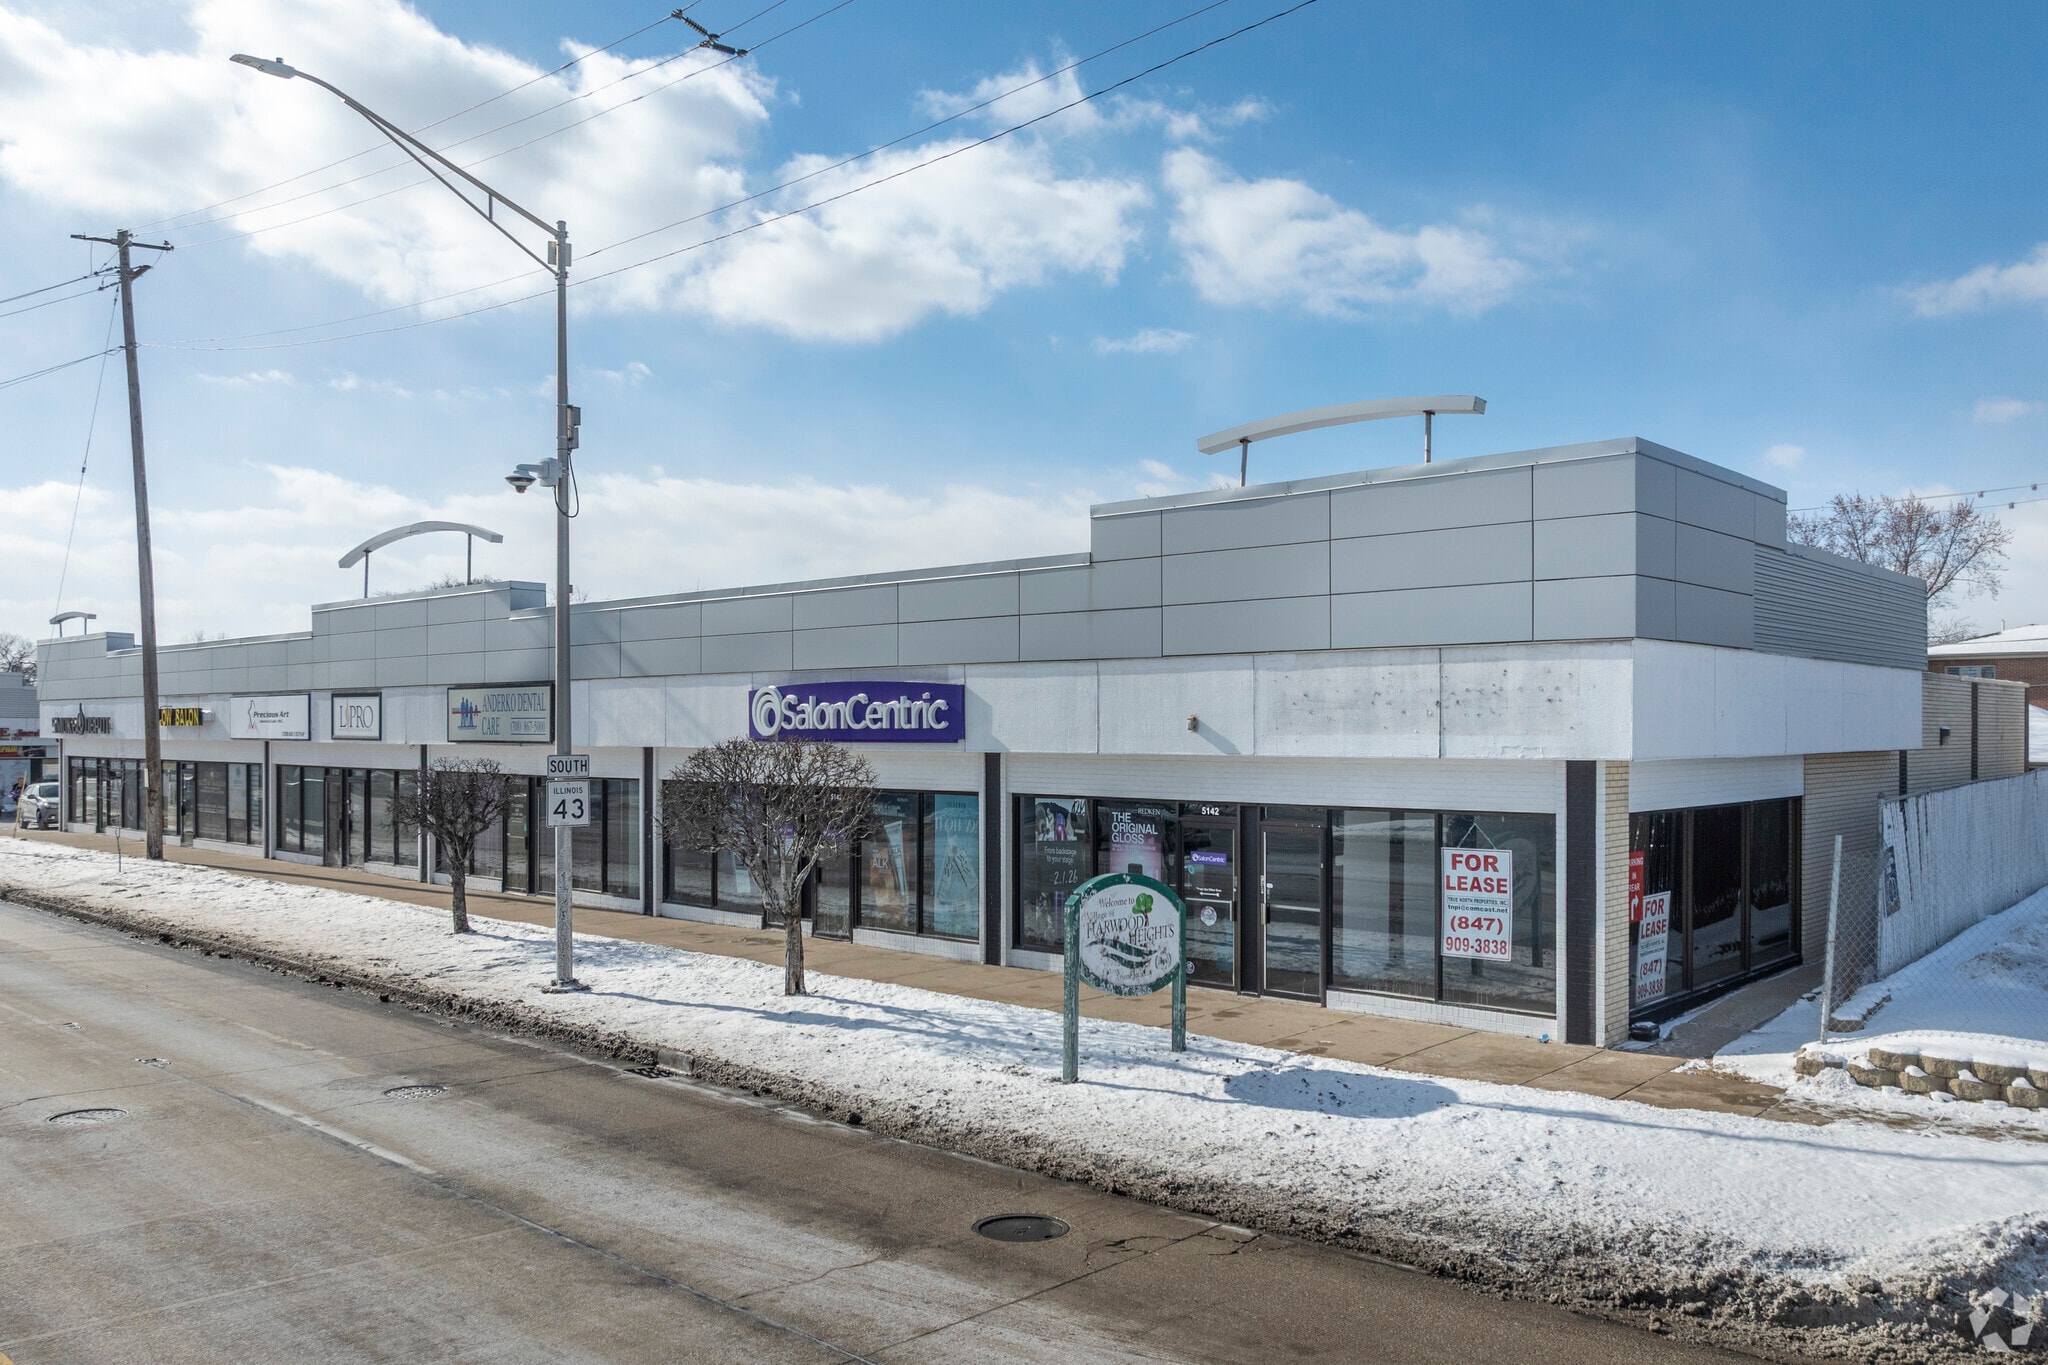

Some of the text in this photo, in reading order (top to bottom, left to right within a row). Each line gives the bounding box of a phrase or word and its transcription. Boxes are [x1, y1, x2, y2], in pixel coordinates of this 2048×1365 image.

[481, 692, 547, 712] ANDERKO DENTAL
[781, 692, 949, 730] SalonCentric
[175, 707, 199, 727] SALON
[279, 710, 290, 718] Art
[481, 716, 500, 736] CARE
[550, 759, 588, 773] SOUTH
[553, 787, 583, 795] ILLINOIS
[553, 798, 584, 820] 43
[1111, 811, 1132, 822] THE
[1137, 807, 1161, 815] REDKEN
[1201, 806, 1220, 816] 5142
[1111, 822, 1158, 835] ORIGINAL
[1111, 833, 1145, 844] GLOSS
[1198, 854, 1226, 864] SalonCentric
[1451, 853, 1499, 873] FOR
[1446, 875, 1508, 894] LEASE
[1631, 871, 1638, 881] IN
[1099, 897, 1127, 908] Welcome
[1447, 904, 1508, 914] tnpi@comcast.net
[1644, 898, 1665, 919] FOR
[1086, 915, 1144, 939] HARWOOD
[1129, 923, 1175, 946] HEIGHTS
[1450, 915, 1503, 935] (847)
[1640, 919, 1667, 939] LEASE
[1446, 936, 1508, 955] 909-3838
[1640, 958, 1662, 980] (847)
[1637, 978, 1664, 1000] 909-3838
